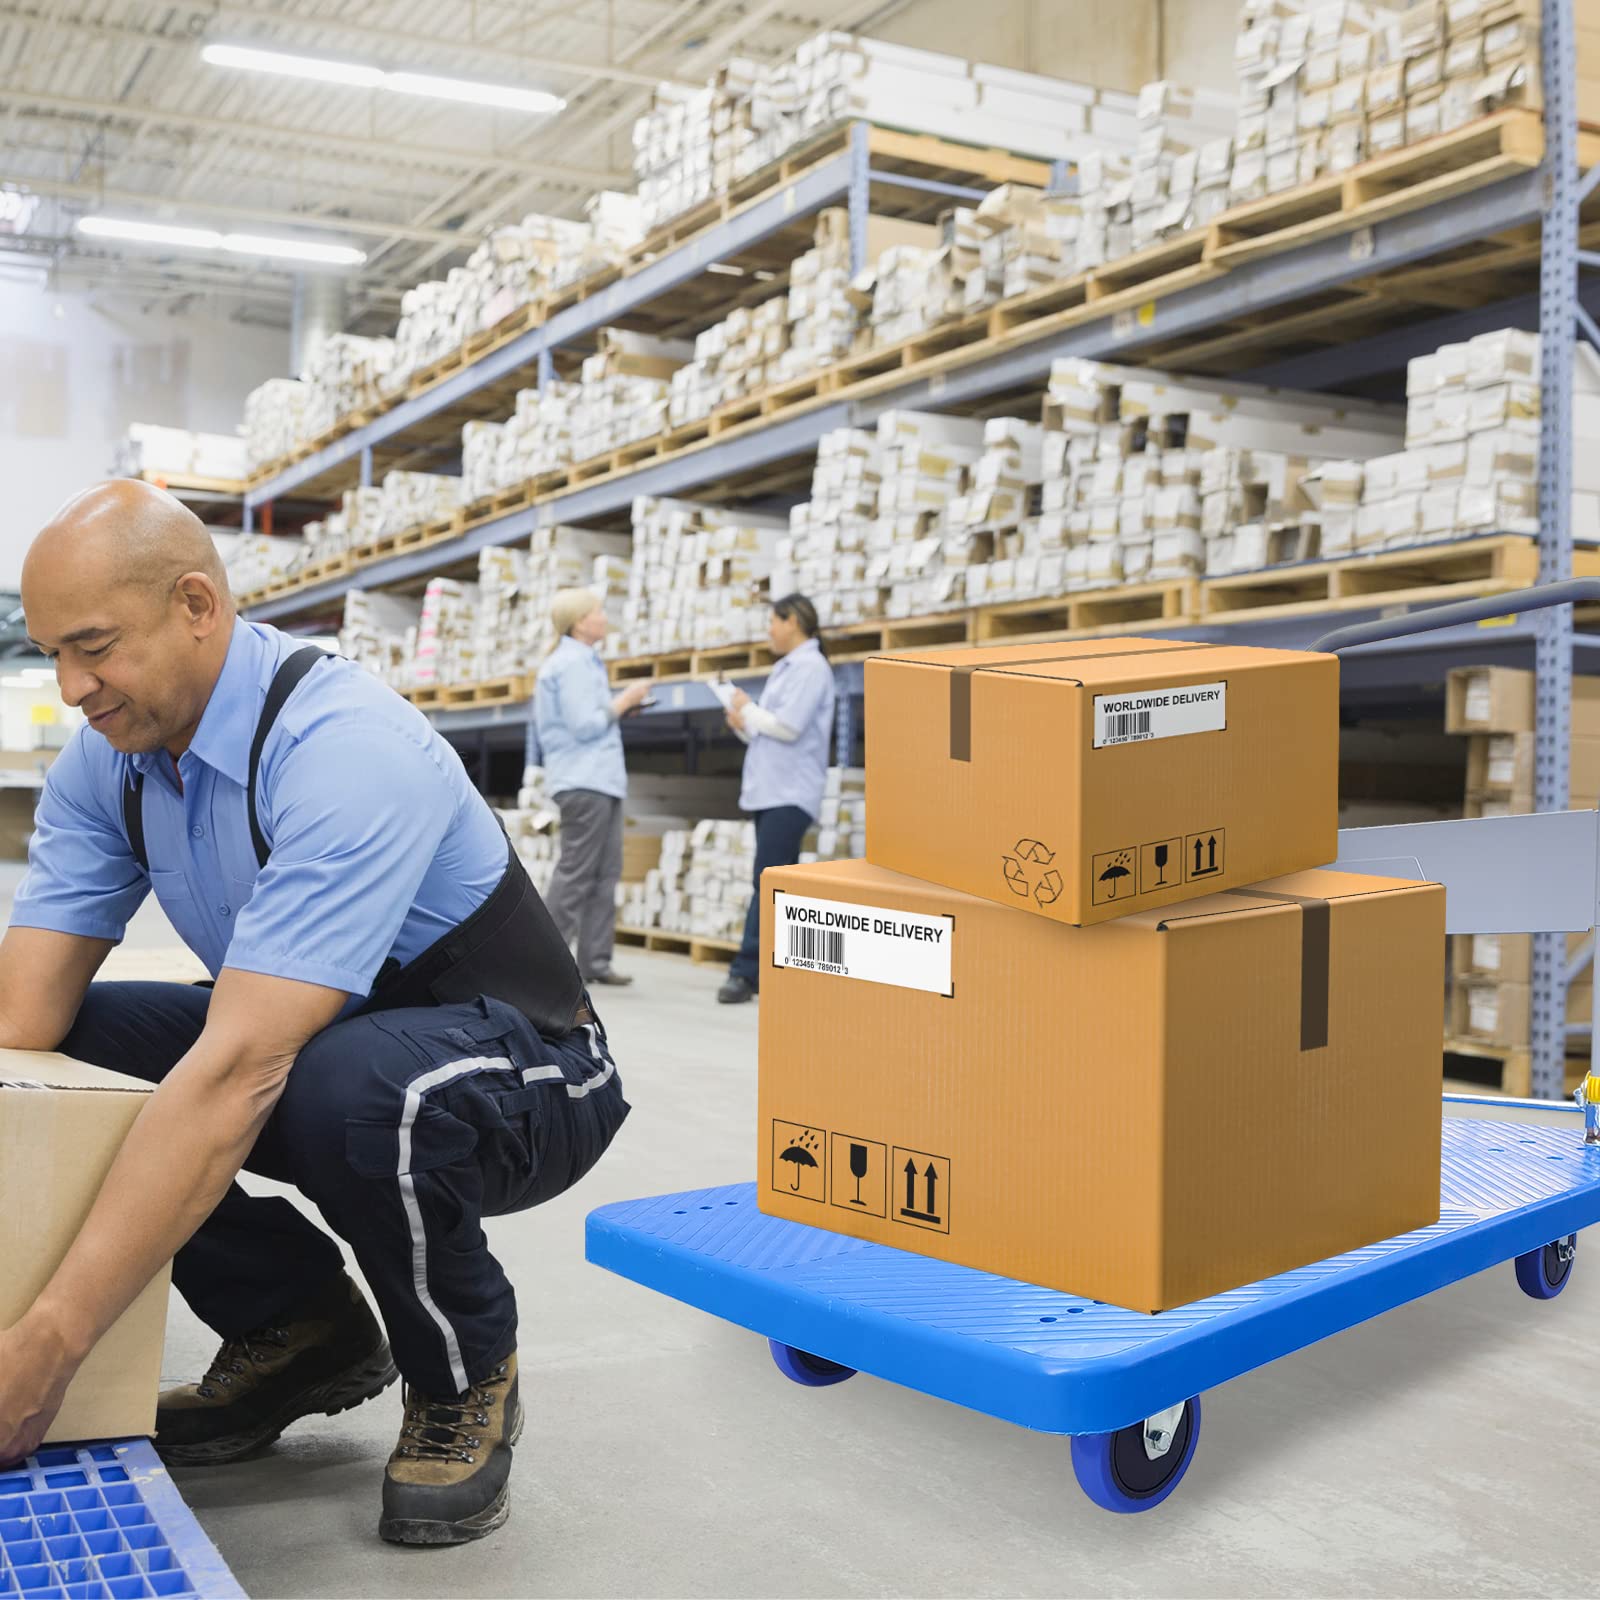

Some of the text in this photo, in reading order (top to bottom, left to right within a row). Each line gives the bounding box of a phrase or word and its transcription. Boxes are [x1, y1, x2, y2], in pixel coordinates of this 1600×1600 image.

[1103, 690, 1221, 713] WORLDWIDE DELIVERY
[785, 905, 943, 943] WORLDWIDE DELIVERY
[792, 958, 815, 969] 123456
[818, 962, 841, 974] 789012
